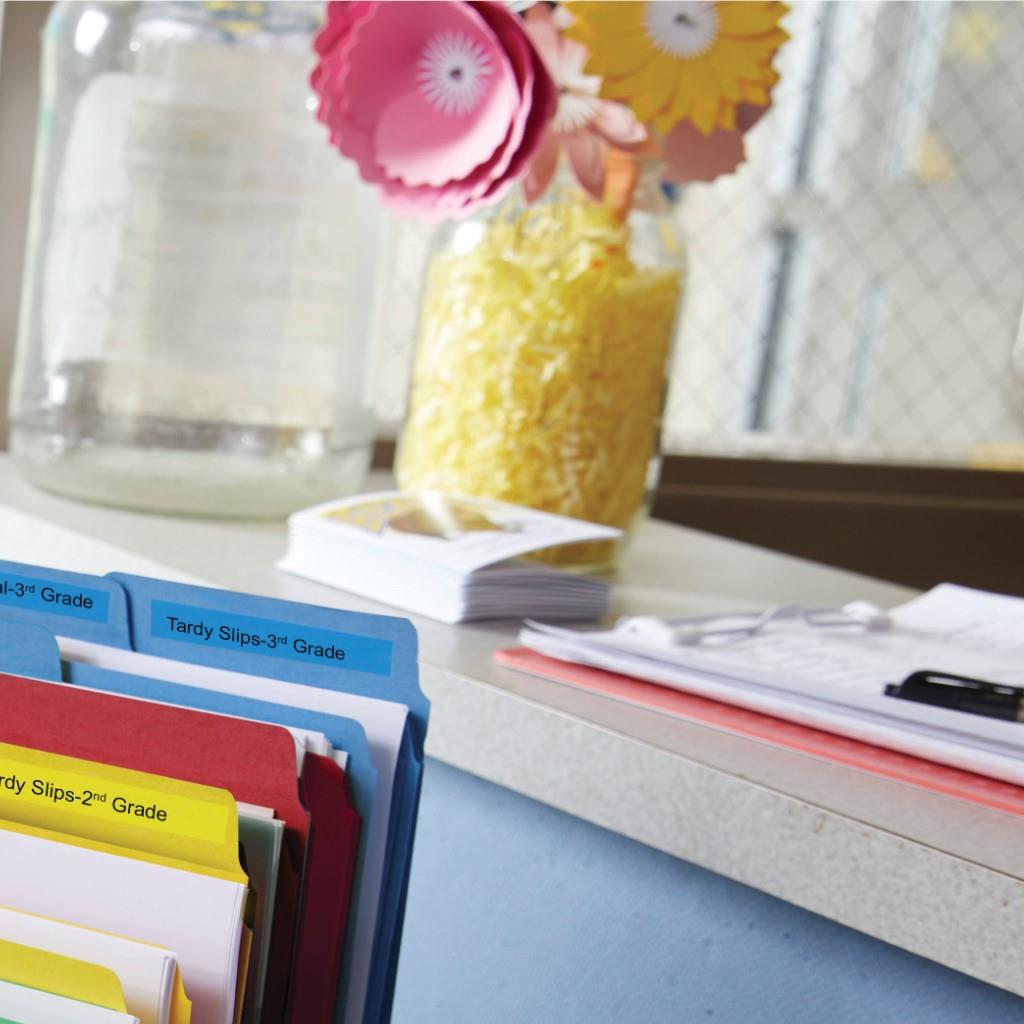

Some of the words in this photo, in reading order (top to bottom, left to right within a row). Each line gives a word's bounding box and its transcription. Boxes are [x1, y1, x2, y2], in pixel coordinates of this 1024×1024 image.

[40, 587, 94, 609] Grade
[166, 616, 214, 641] Tardy
[293, 638, 346, 661] Grade
[111, 797, 168, 822] Grade
